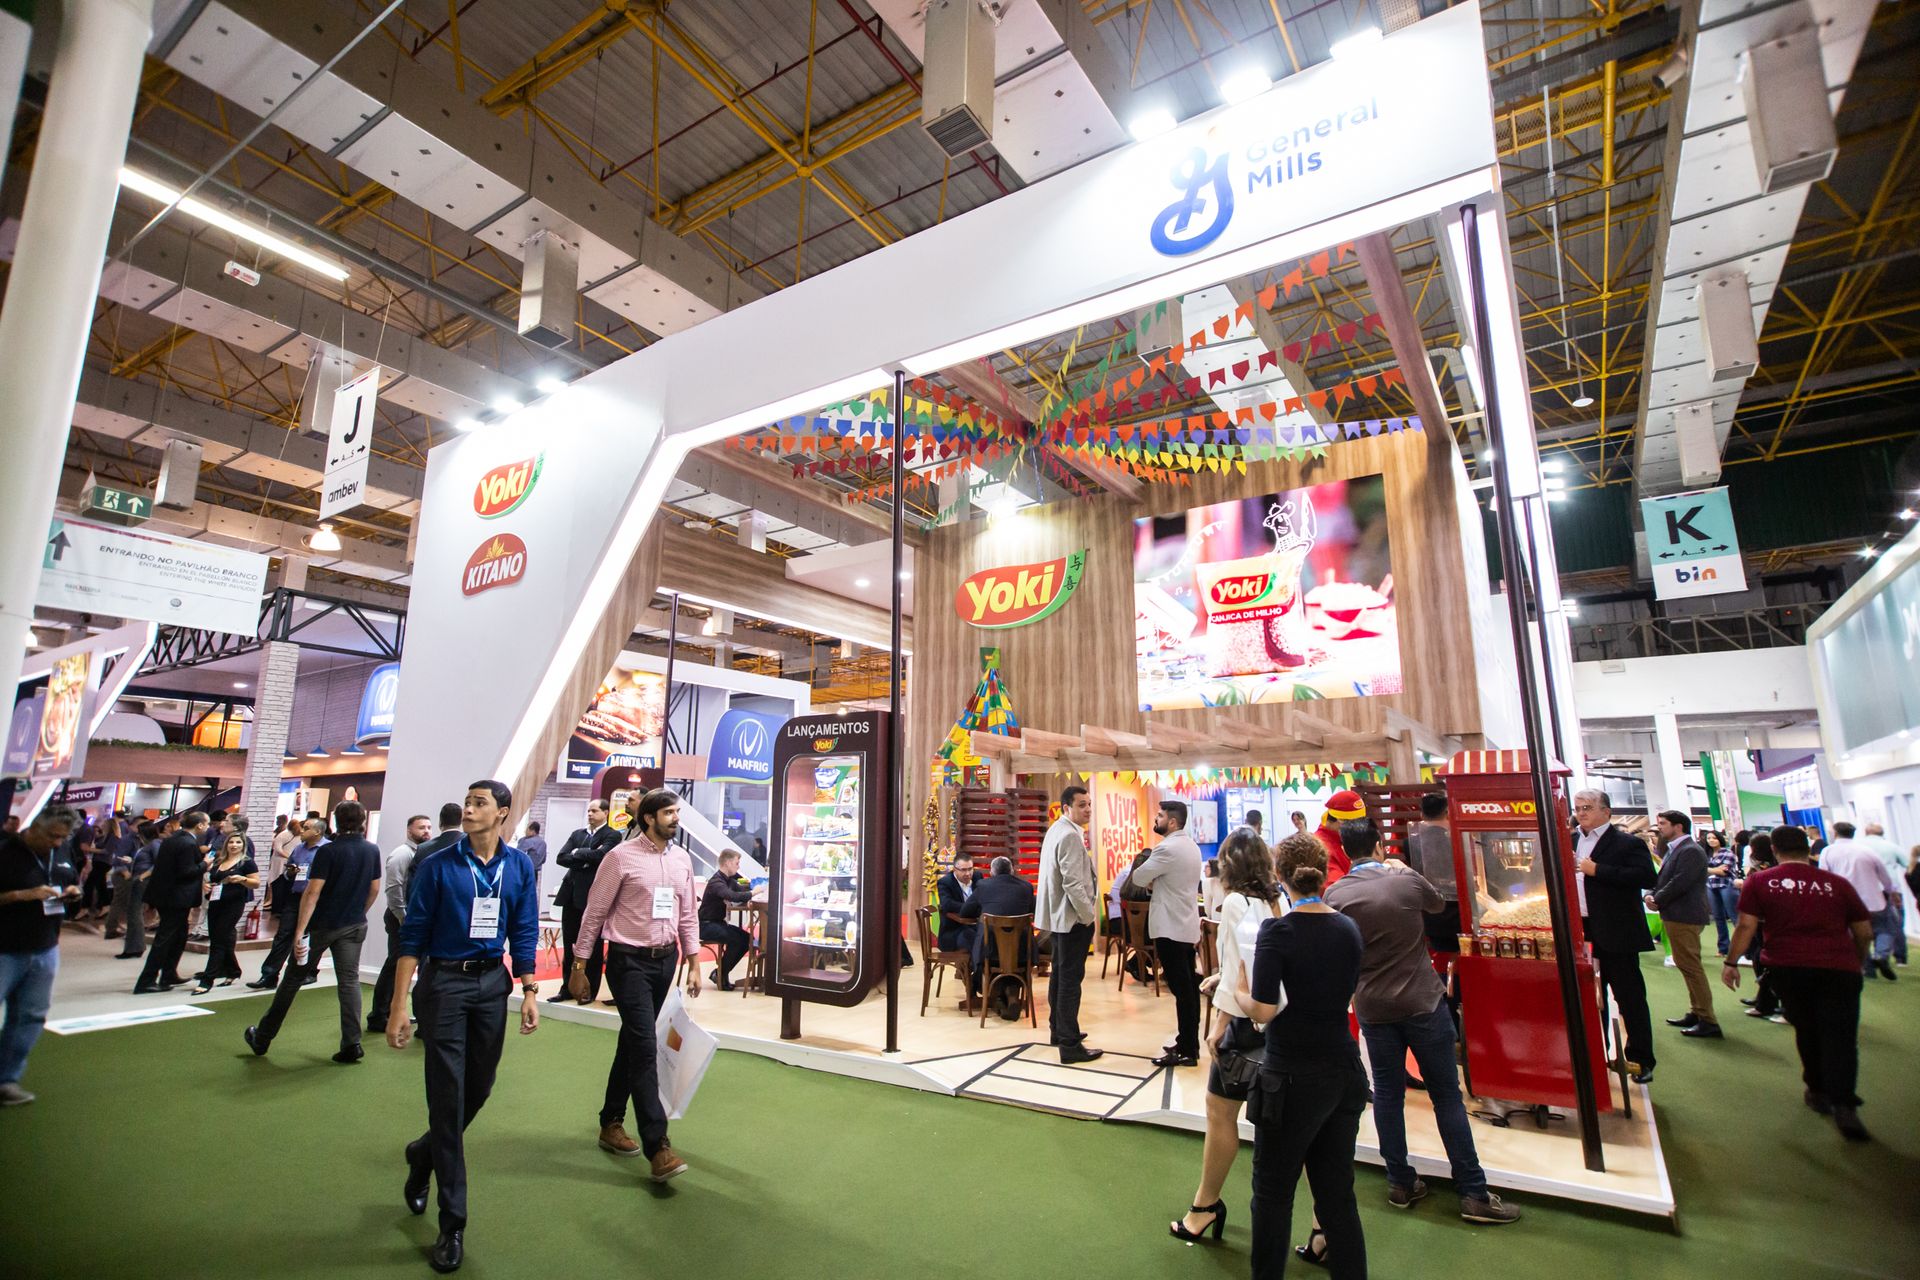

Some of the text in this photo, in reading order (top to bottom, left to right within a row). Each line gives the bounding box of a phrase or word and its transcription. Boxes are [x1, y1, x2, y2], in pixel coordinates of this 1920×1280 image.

[1246, 96, 1378, 162] General
[1248, 152, 1322, 193] Mills
[344, 395, 362, 443] J
[328, 481, 358, 502] ambev
[480, 460, 530, 513] Yoki
[1665, 505, 1712, 544] K
[100, 545, 155, 561] ENTRANDO
[176, 560, 220, 573] PAVILHÃO
[222, 569, 258, 580] BRANCO
[139, 561, 177, 571] ENTRANDO
[465, 551, 523, 590] KITANO
[1675, 566, 1717, 583] bin
[964, 564, 1055, 621] Yoki
[1216, 576, 1263, 602] Yoki
[1211, 612, 1241, 622] CANJICA
[1256, 607, 1282, 616] MILHO
[787, 722, 870, 738] LANÇAMENTOS
[815, 739, 833, 750] Yoki
[610, 755, 652, 768] MONTANA
[727, 757, 769, 772] MARFRIG
[1461, 803, 1504, 814] PIPOCA
[1113, 826, 1144, 852] SUAS
